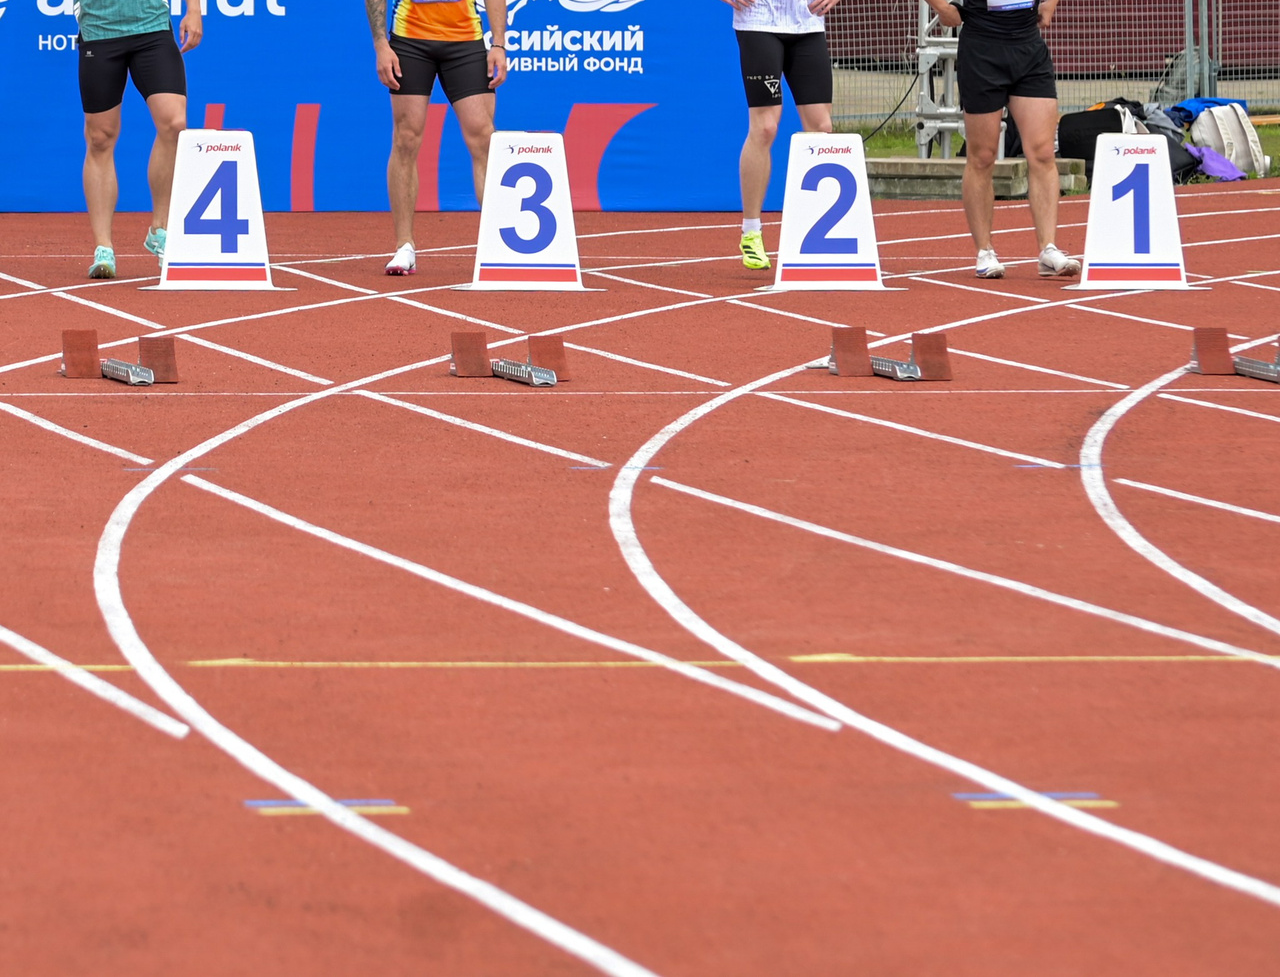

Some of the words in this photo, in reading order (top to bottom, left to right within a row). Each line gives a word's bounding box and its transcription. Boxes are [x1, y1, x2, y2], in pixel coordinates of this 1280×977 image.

[583, 56, 643, 74] ФОНД
[205, 143, 242, 154] polanik
[517, 145, 553, 155] polanik
[817, 146, 852, 155] polanik
[1122, 146, 1157, 156] polanik
[183, 160, 250, 254] 4
[499, 162, 558, 255] 3
[799, 162, 859, 255] 2
[1111, 163, 1151, 254] 1
